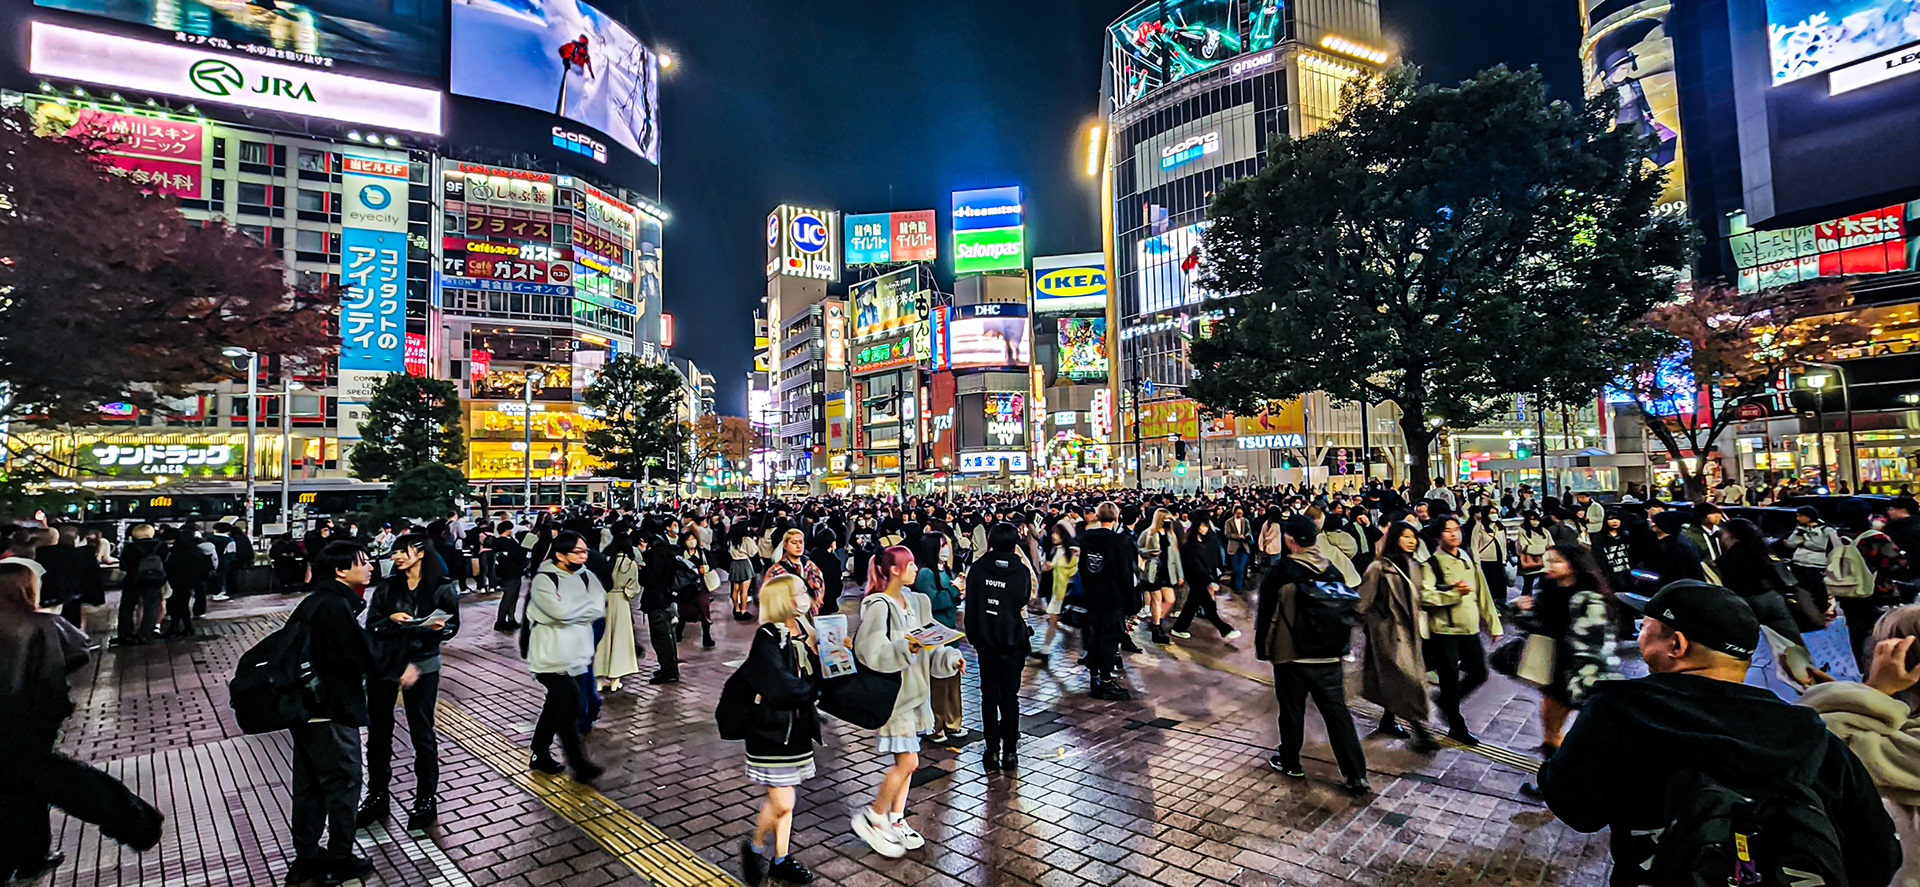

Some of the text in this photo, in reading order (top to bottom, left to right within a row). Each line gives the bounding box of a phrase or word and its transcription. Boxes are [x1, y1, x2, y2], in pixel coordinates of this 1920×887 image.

[251, 75, 317, 103] JRA
[128, 136, 187, 154] リニック
[552, 125, 608, 154] GoPro
[1162, 130, 1218, 158] GoPro
[445, 181, 464, 193] 9F
[496, 185, 547, 204] しゃぶ葉
[350, 211, 399, 226] eyecity
[793, 221, 826, 246] UC
[573, 229, 621, 259] コンタクト
[957, 242, 1020, 259] Salonpas
[520, 245, 562, 262] ガスト
[444, 258, 465, 271] 7F
[468, 260, 492, 271] Café
[493, 260, 544, 281] ガスト
[815, 263, 832, 272] VISA
[1043, 274, 1106, 291] IKEA
[347, 246, 376, 350] アイシティ
[377, 247, 398, 350] コンタクトの
[975, 304, 1001, 316] DHC
[988, 421, 1023, 435] DMM
[997, 434, 1014, 445] TV
[1236, 433, 1304, 450] TSUTAYA
[92, 444, 231, 465] サンドラッグ
[963, 456, 1022, 467] 大盛堂店
[985, 578, 1006, 589] YOUTH
